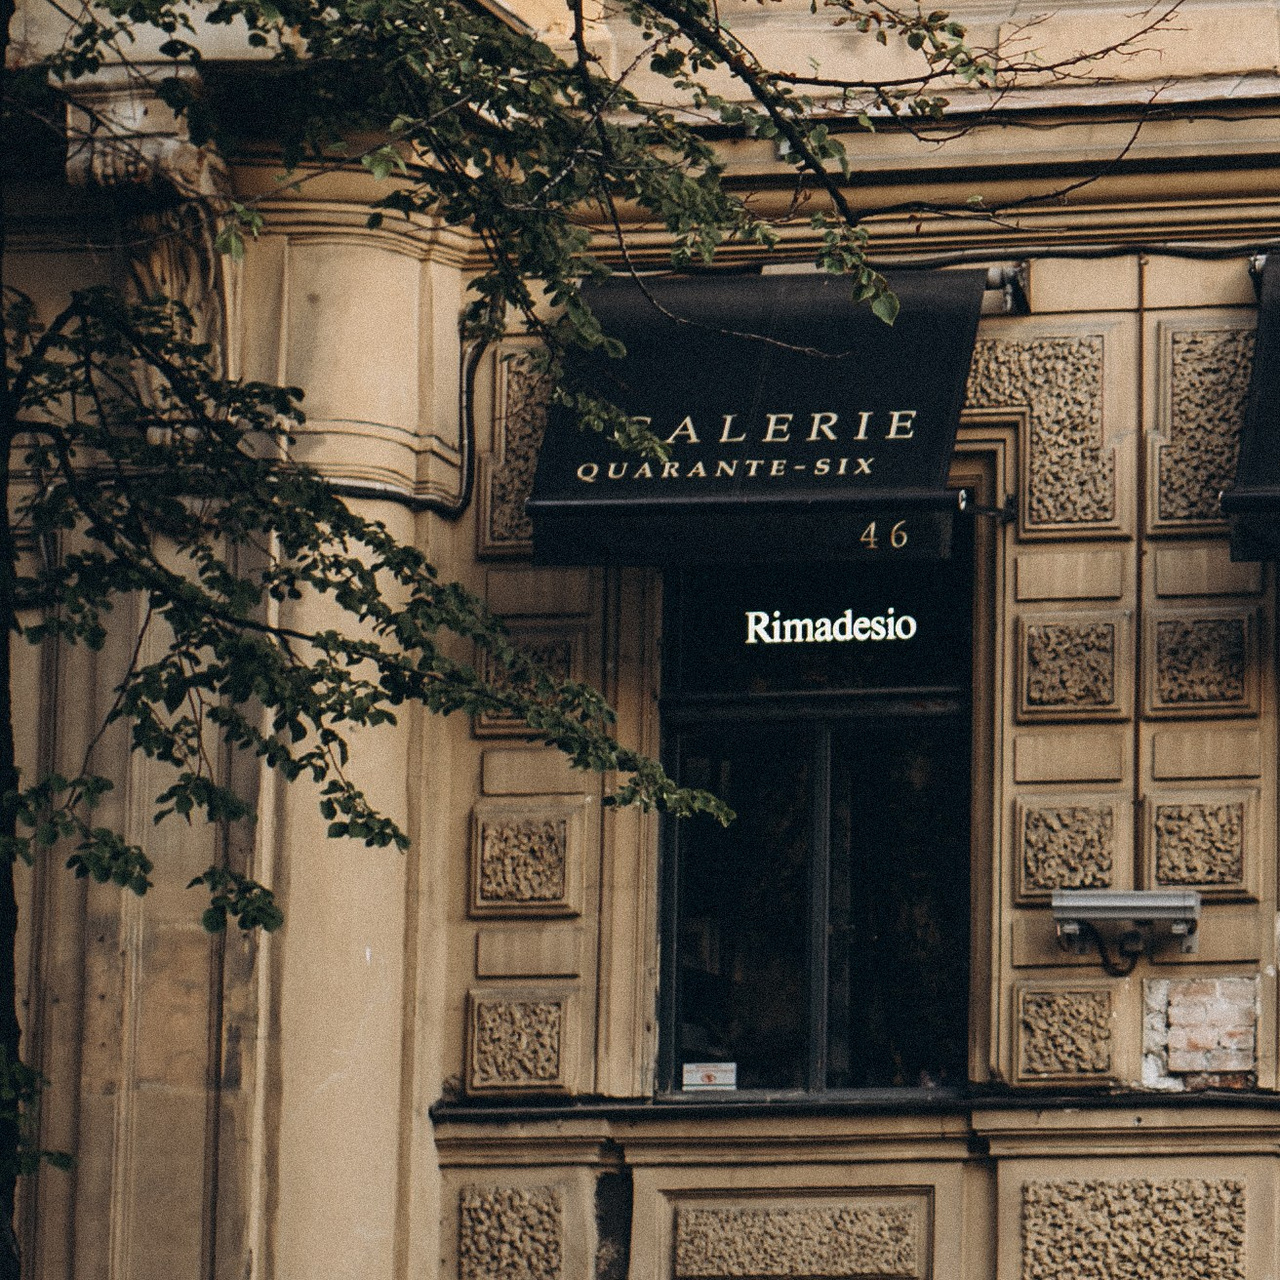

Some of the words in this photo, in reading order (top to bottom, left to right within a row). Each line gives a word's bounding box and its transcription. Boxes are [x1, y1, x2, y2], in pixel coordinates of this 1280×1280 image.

[576, 457, 875, 483] QUARANTE-SIX
[860, 519, 909, 549] 46
[745, 607, 917, 644] Rimadesio
